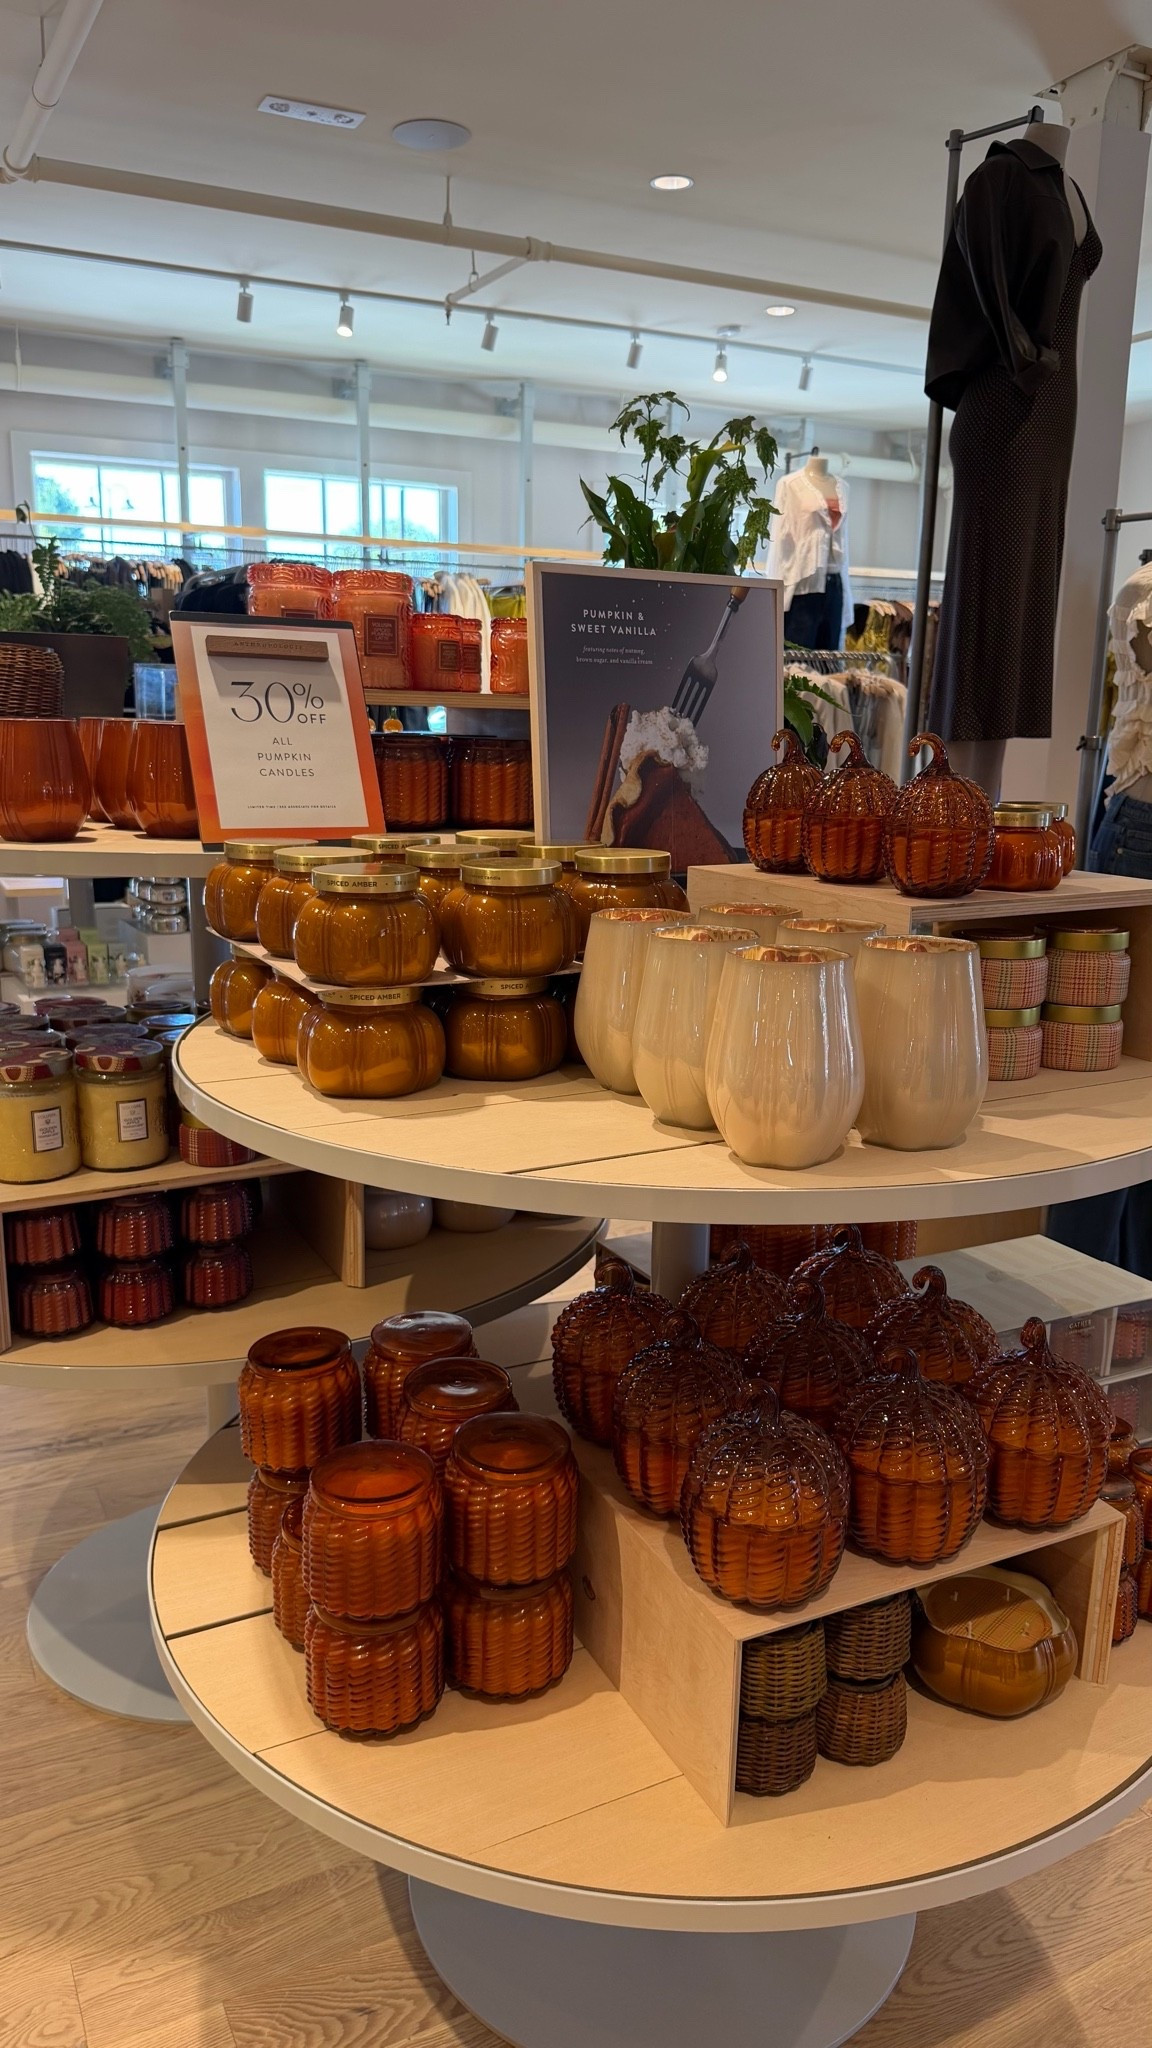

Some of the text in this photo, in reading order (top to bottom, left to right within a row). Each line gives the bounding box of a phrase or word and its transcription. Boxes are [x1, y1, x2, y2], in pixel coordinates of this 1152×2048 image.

[583, 609, 644, 621] PUMPKIN &
[571, 624, 656, 636] SWEET VANILLA
[230, 682, 324, 723] 30%
[297, 714, 327, 724] OFF
[272, 737, 292, 746] ALL
[258, 752, 312, 762] PUMPKIN
[260, 768, 315, 777] CANDLES
